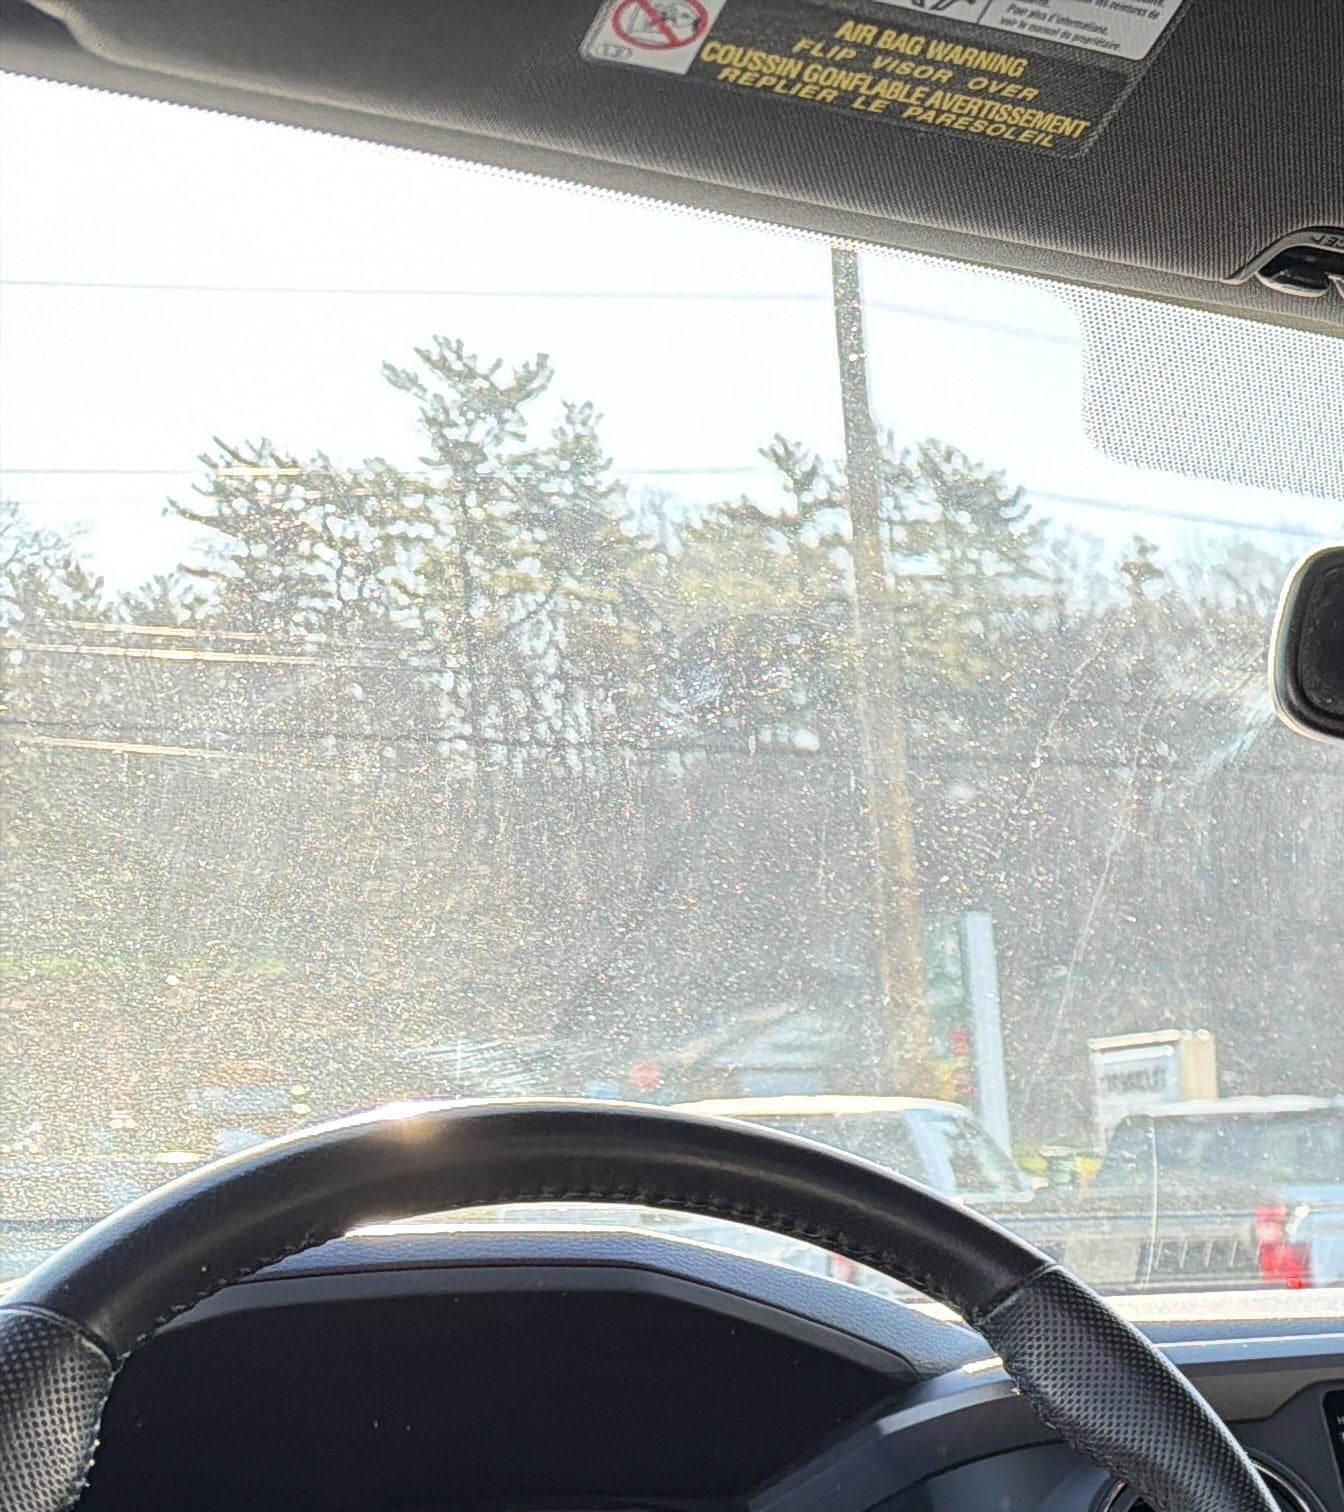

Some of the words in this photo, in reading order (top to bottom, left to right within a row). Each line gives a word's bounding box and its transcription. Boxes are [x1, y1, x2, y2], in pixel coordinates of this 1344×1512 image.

[792, 37, 857, 62] FLIP
[872, 55, 954, 84] VISOR
[967, 76, 1040, 102] OVER
[834, 20, 878, 45] AIR
[876, 29, 926, 56] BAG
[925, 40, 1029, 78] WARNING
[700, 40, 804, 79] COUSSIN
[802, 63, 930, 106] GONFLABLE
[925, 90, 1091, 139] AVERTISSEMENT
[717, 67, 839, 103] REPLIER
[852, 95, 890, 113] LE
[902, 106, 1057, 147] PARESOLEIL
